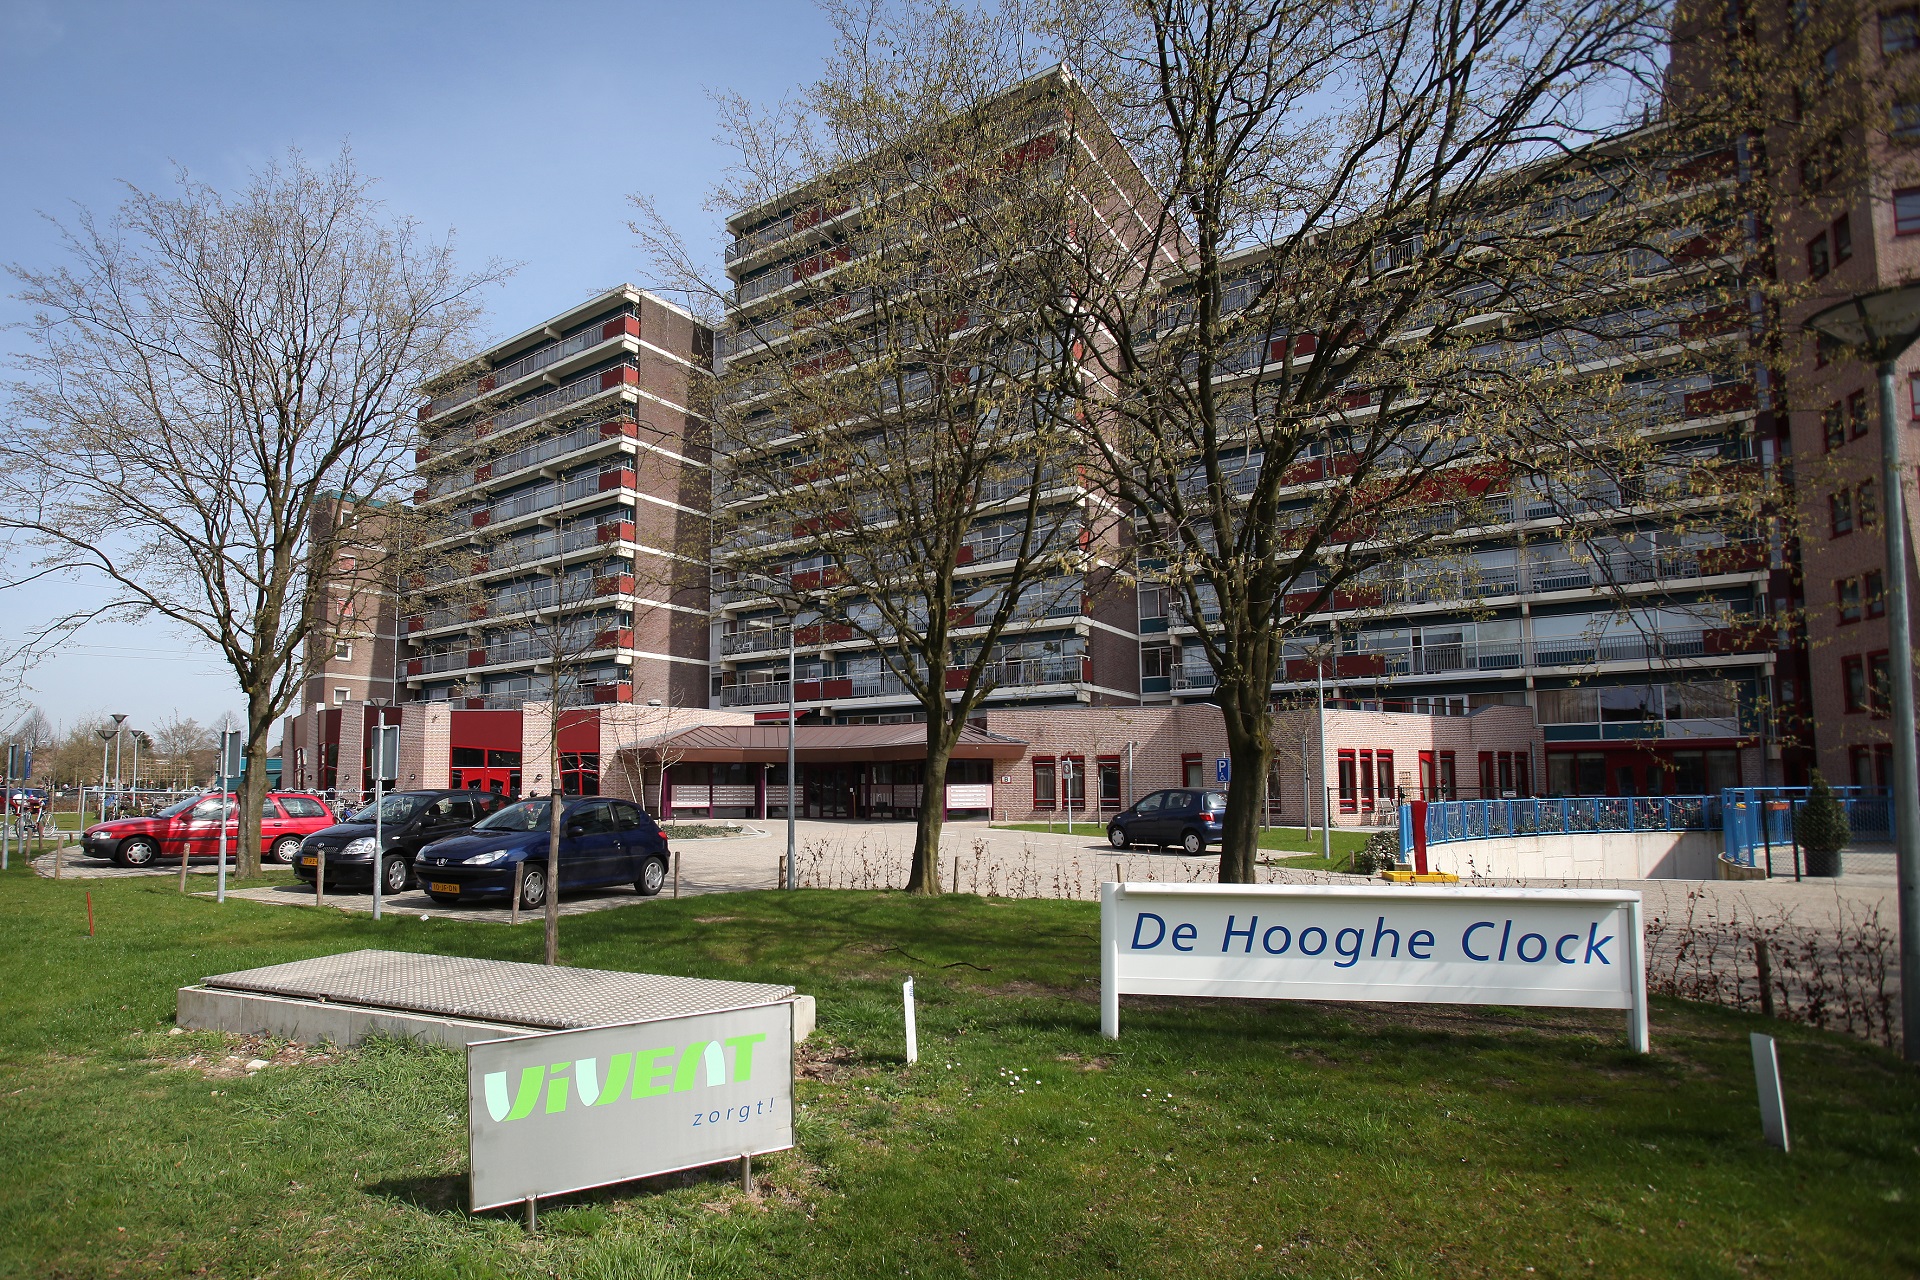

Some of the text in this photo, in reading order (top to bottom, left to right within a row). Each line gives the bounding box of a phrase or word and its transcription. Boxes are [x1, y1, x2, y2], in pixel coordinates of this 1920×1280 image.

[1218, 760, 1227, 773] P
[1131, 913, 1616, 969] De Hooghe Clock
[692, 1097, 775, 1127] zorgt!
